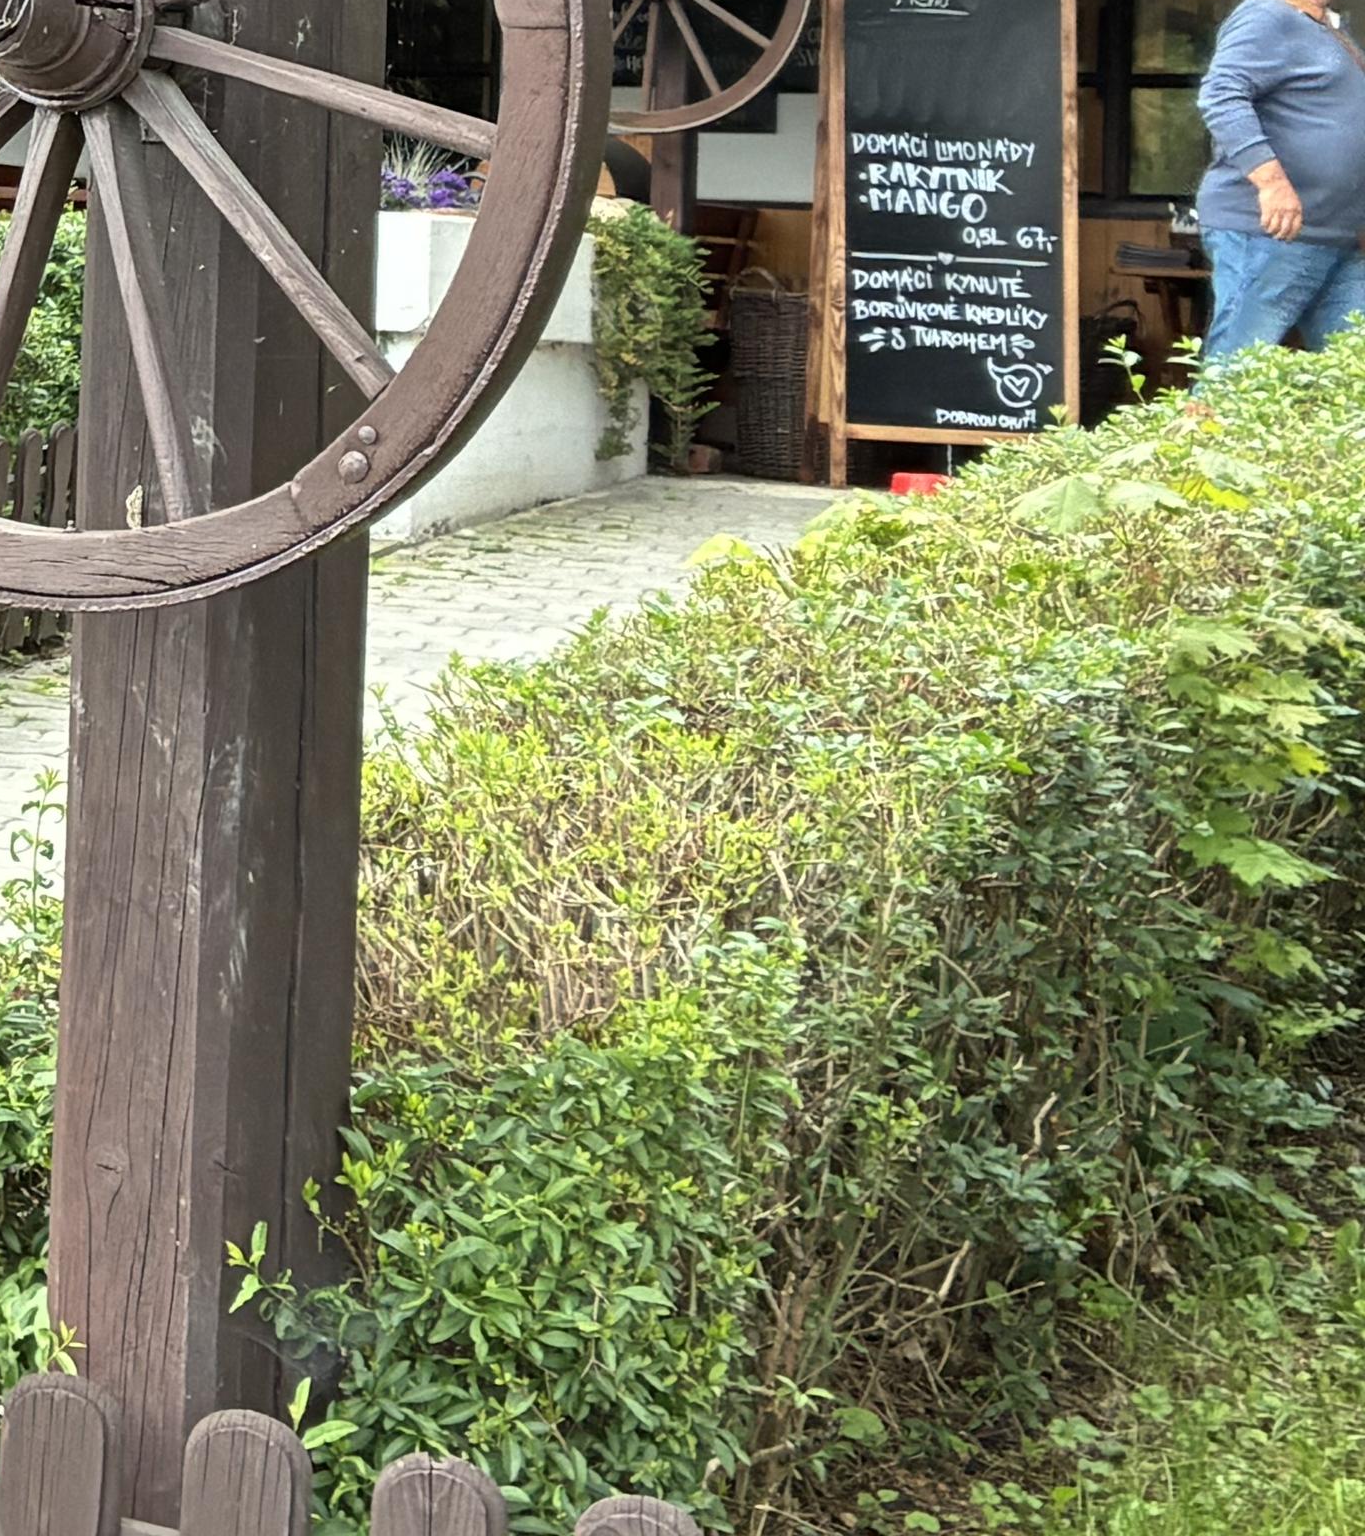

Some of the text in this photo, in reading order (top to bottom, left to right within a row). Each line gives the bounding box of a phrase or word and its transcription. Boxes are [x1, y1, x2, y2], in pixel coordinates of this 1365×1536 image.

[851, 132, 1035, 167] DOMÁCÍ LIMONÁDY
[869, 188, 987, 223] MANGO
[962, 227, 1008, 248] 0,5L
[851, 264, 1032, 298] DOMÁCÍ KYNUTÉ
[891, 327, 906, 350] S
